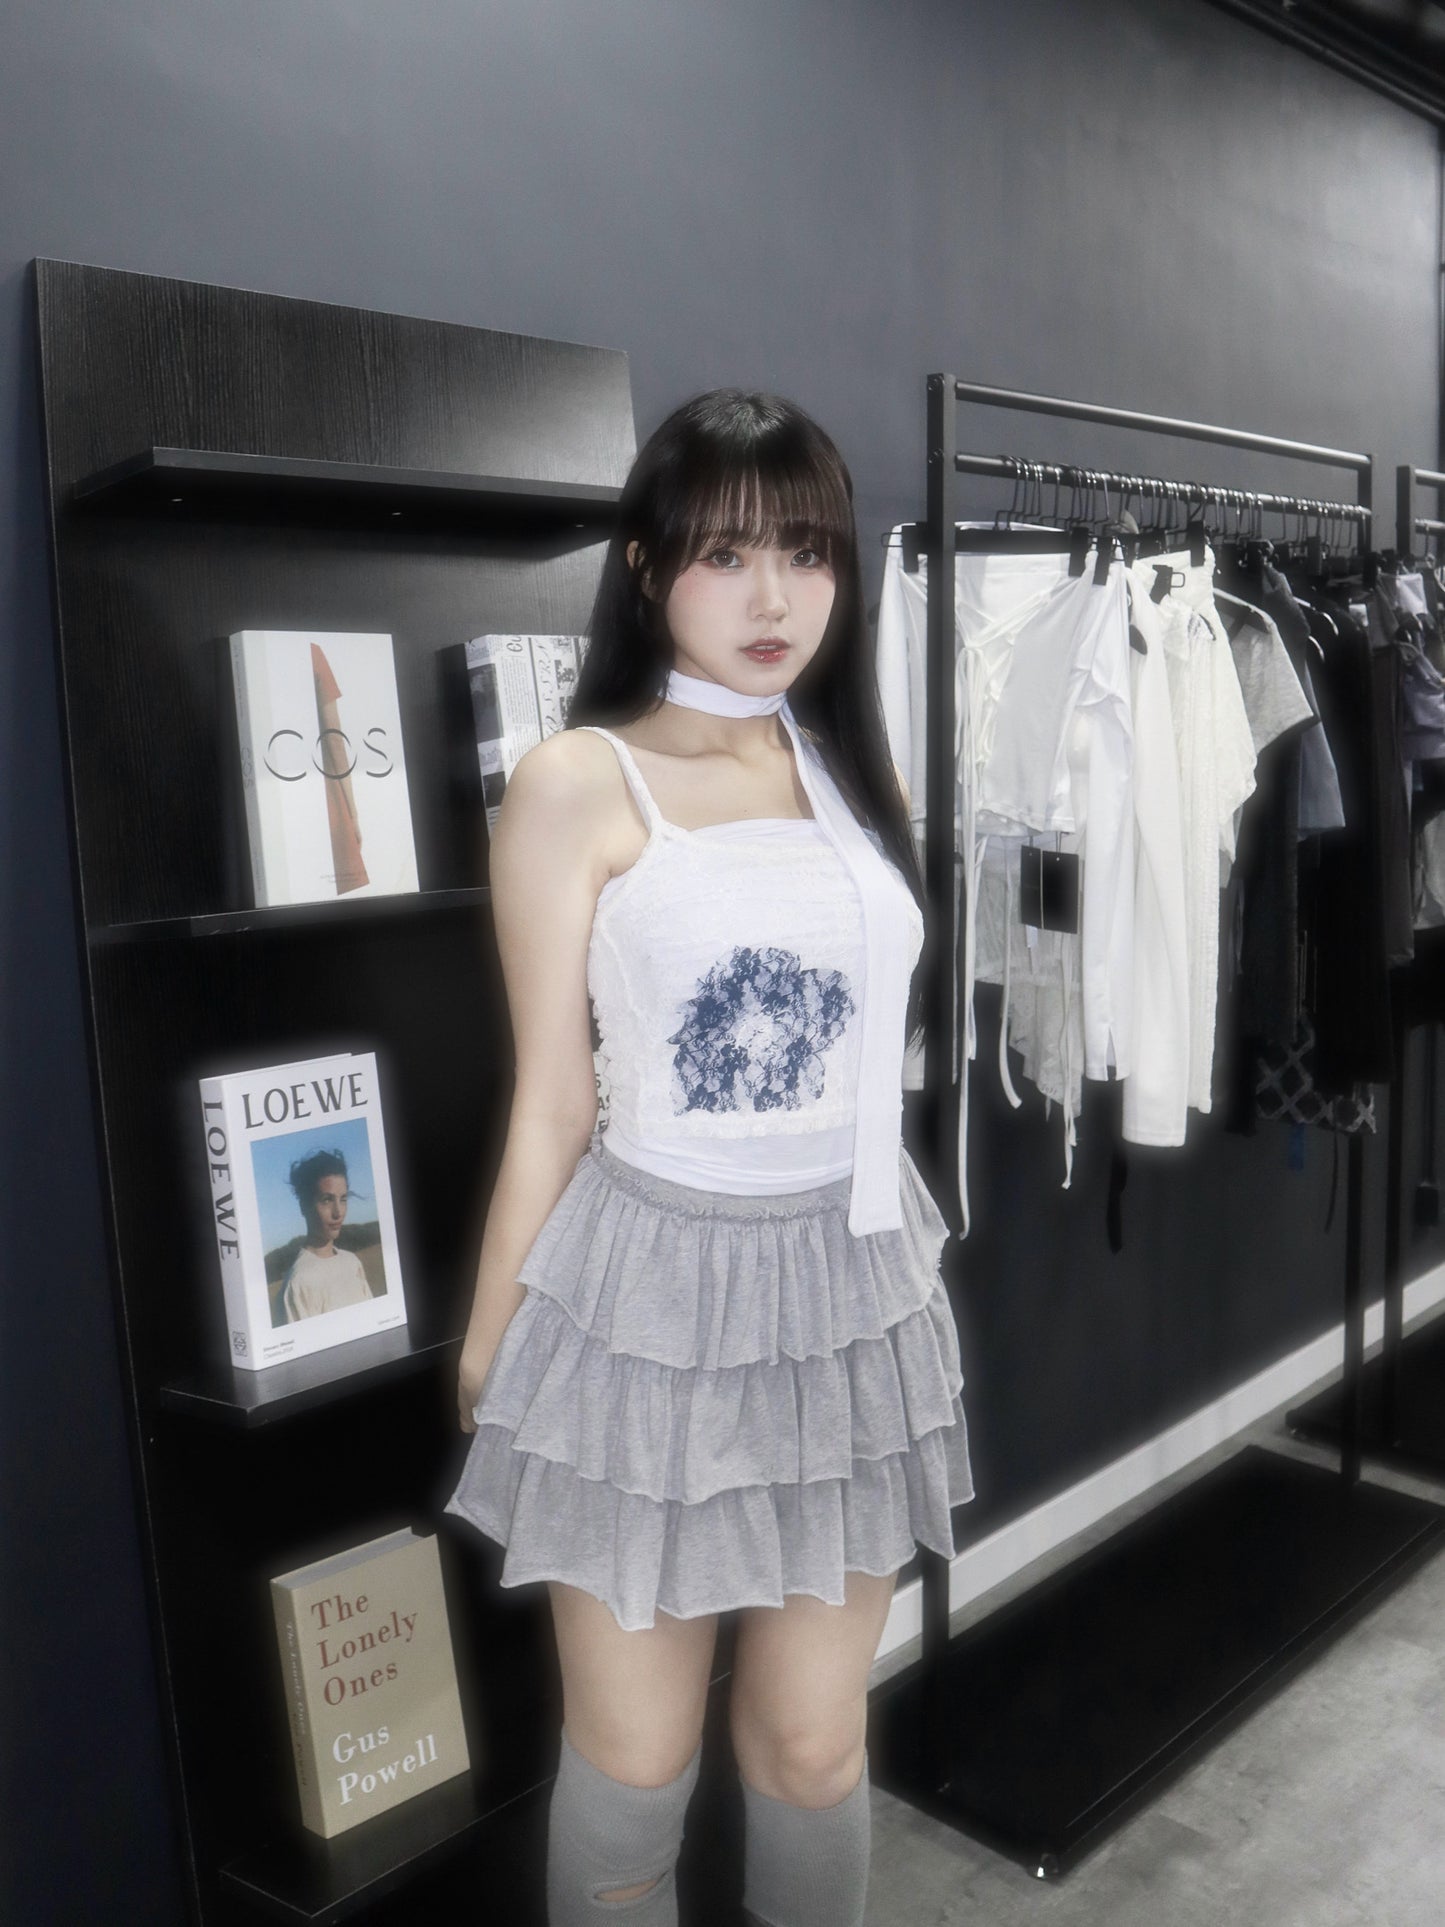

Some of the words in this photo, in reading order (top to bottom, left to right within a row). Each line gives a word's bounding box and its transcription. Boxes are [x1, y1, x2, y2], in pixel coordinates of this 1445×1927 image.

[263, 727, 394, 782] COS
[241, 1072, 369, 1130] LOEWE
[202, 1100, 240, 1261] LOEWE
[310, 1593, 370, 1631] The
[316, 1611, 418, 1670] Lonely
[323, 1662, 399, 1707] Ones
[332, 1725, 391, 1765] Gus
[336, 1734, 440, 1807] Powell
